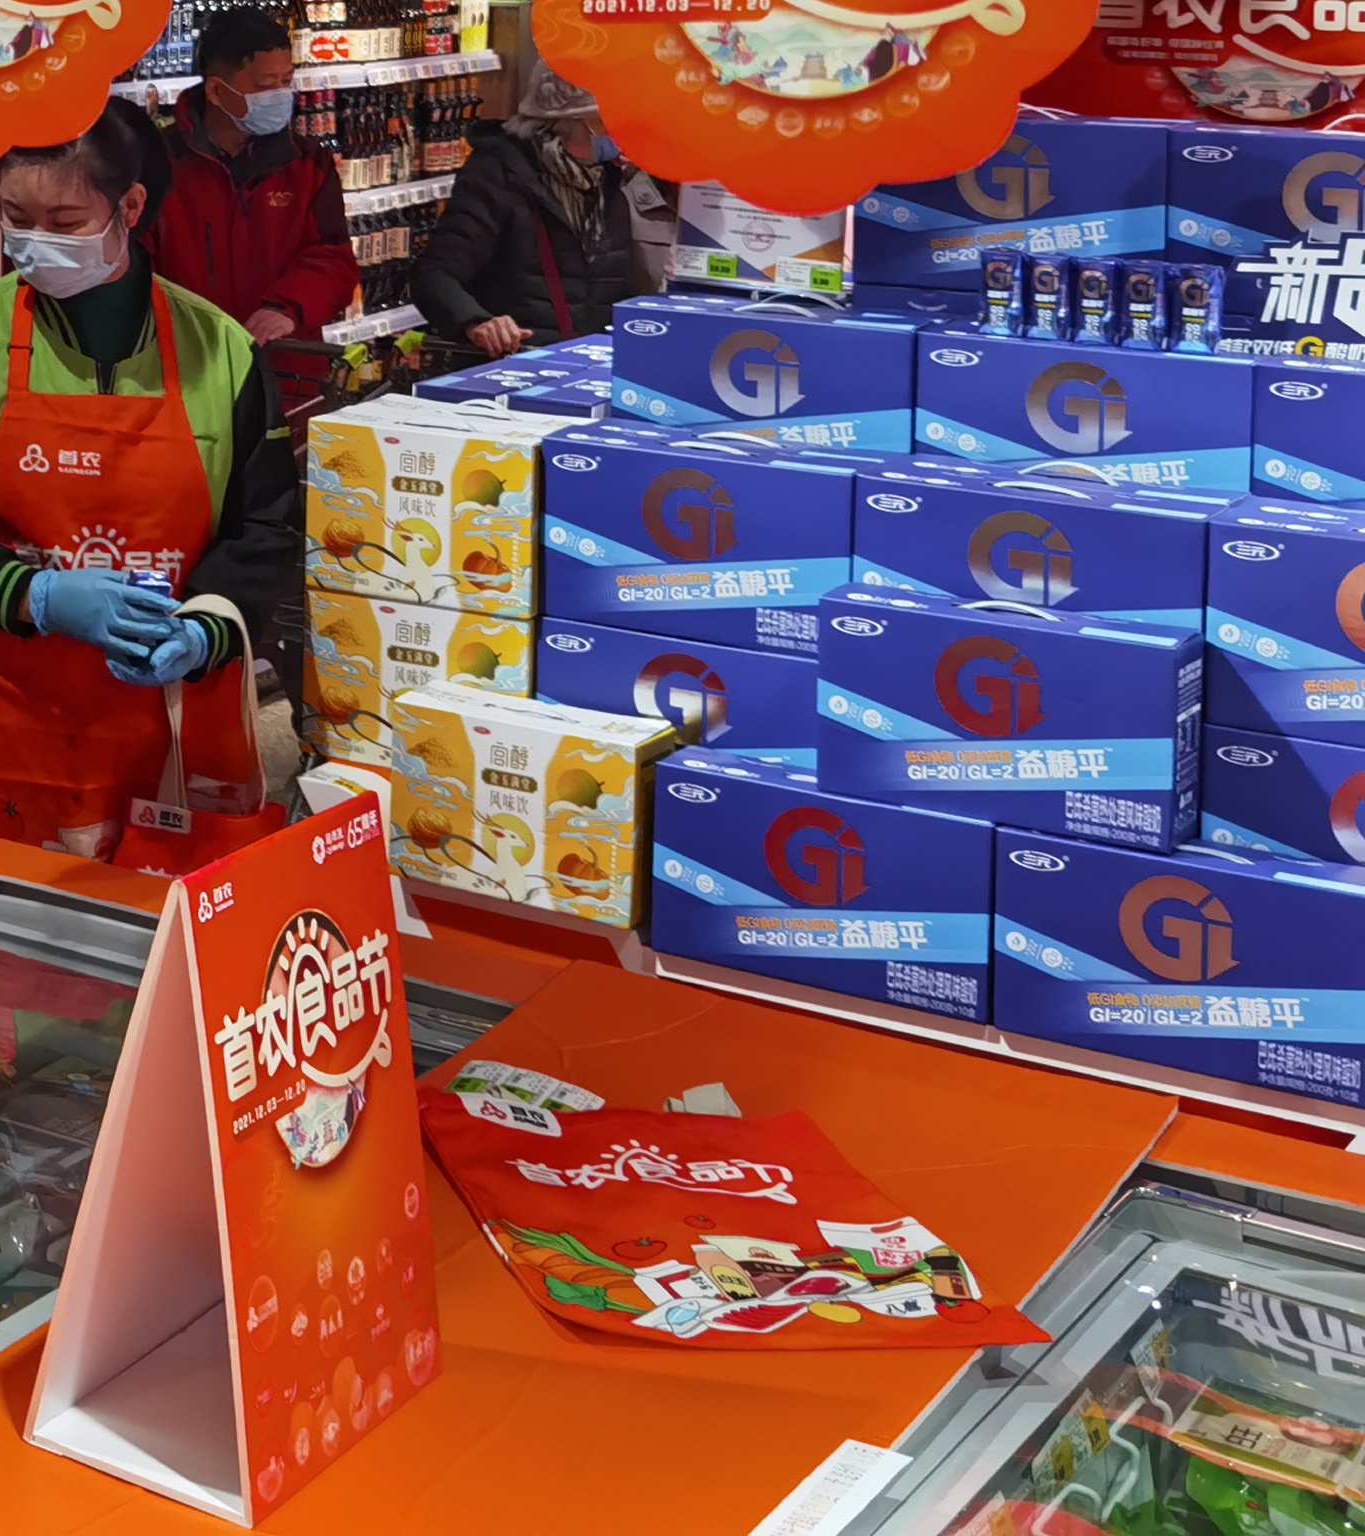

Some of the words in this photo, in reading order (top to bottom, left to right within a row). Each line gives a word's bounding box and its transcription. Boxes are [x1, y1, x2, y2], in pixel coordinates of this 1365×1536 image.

[400, 450, 437, 475] 宫醇
[398, 497, 437, 518] 风味饮
[618, 586, 664, 602] GI=20
[671, 585, 711, 600] GL=2
[712, 567, 794, 598] 益糖平
[395, 620, 432, 645] 宫醇
[1306, 695, 1363, 711] GI=20
[489, 742, 530, 768] 宫醇
[1016, 747, 1109, 779] 益糖平
[907, 764, 960, 780] GI=20
[968, 764, 1014, 780] GL=2
[489, 793, 530, 816] 风味饮
[738, 930, 786, 946] GI=20
[794, 931, 839, 947] GL=2
[840, 919, 927, 950] 益糖平
[215, 929, 392, 1102] 首农食品节
[1089, 1007, 1144, 1024] GI=20
[1154, 1010, 1202, 1026] GL=2
[1205, 995, 1305, 1029] 益糖平
